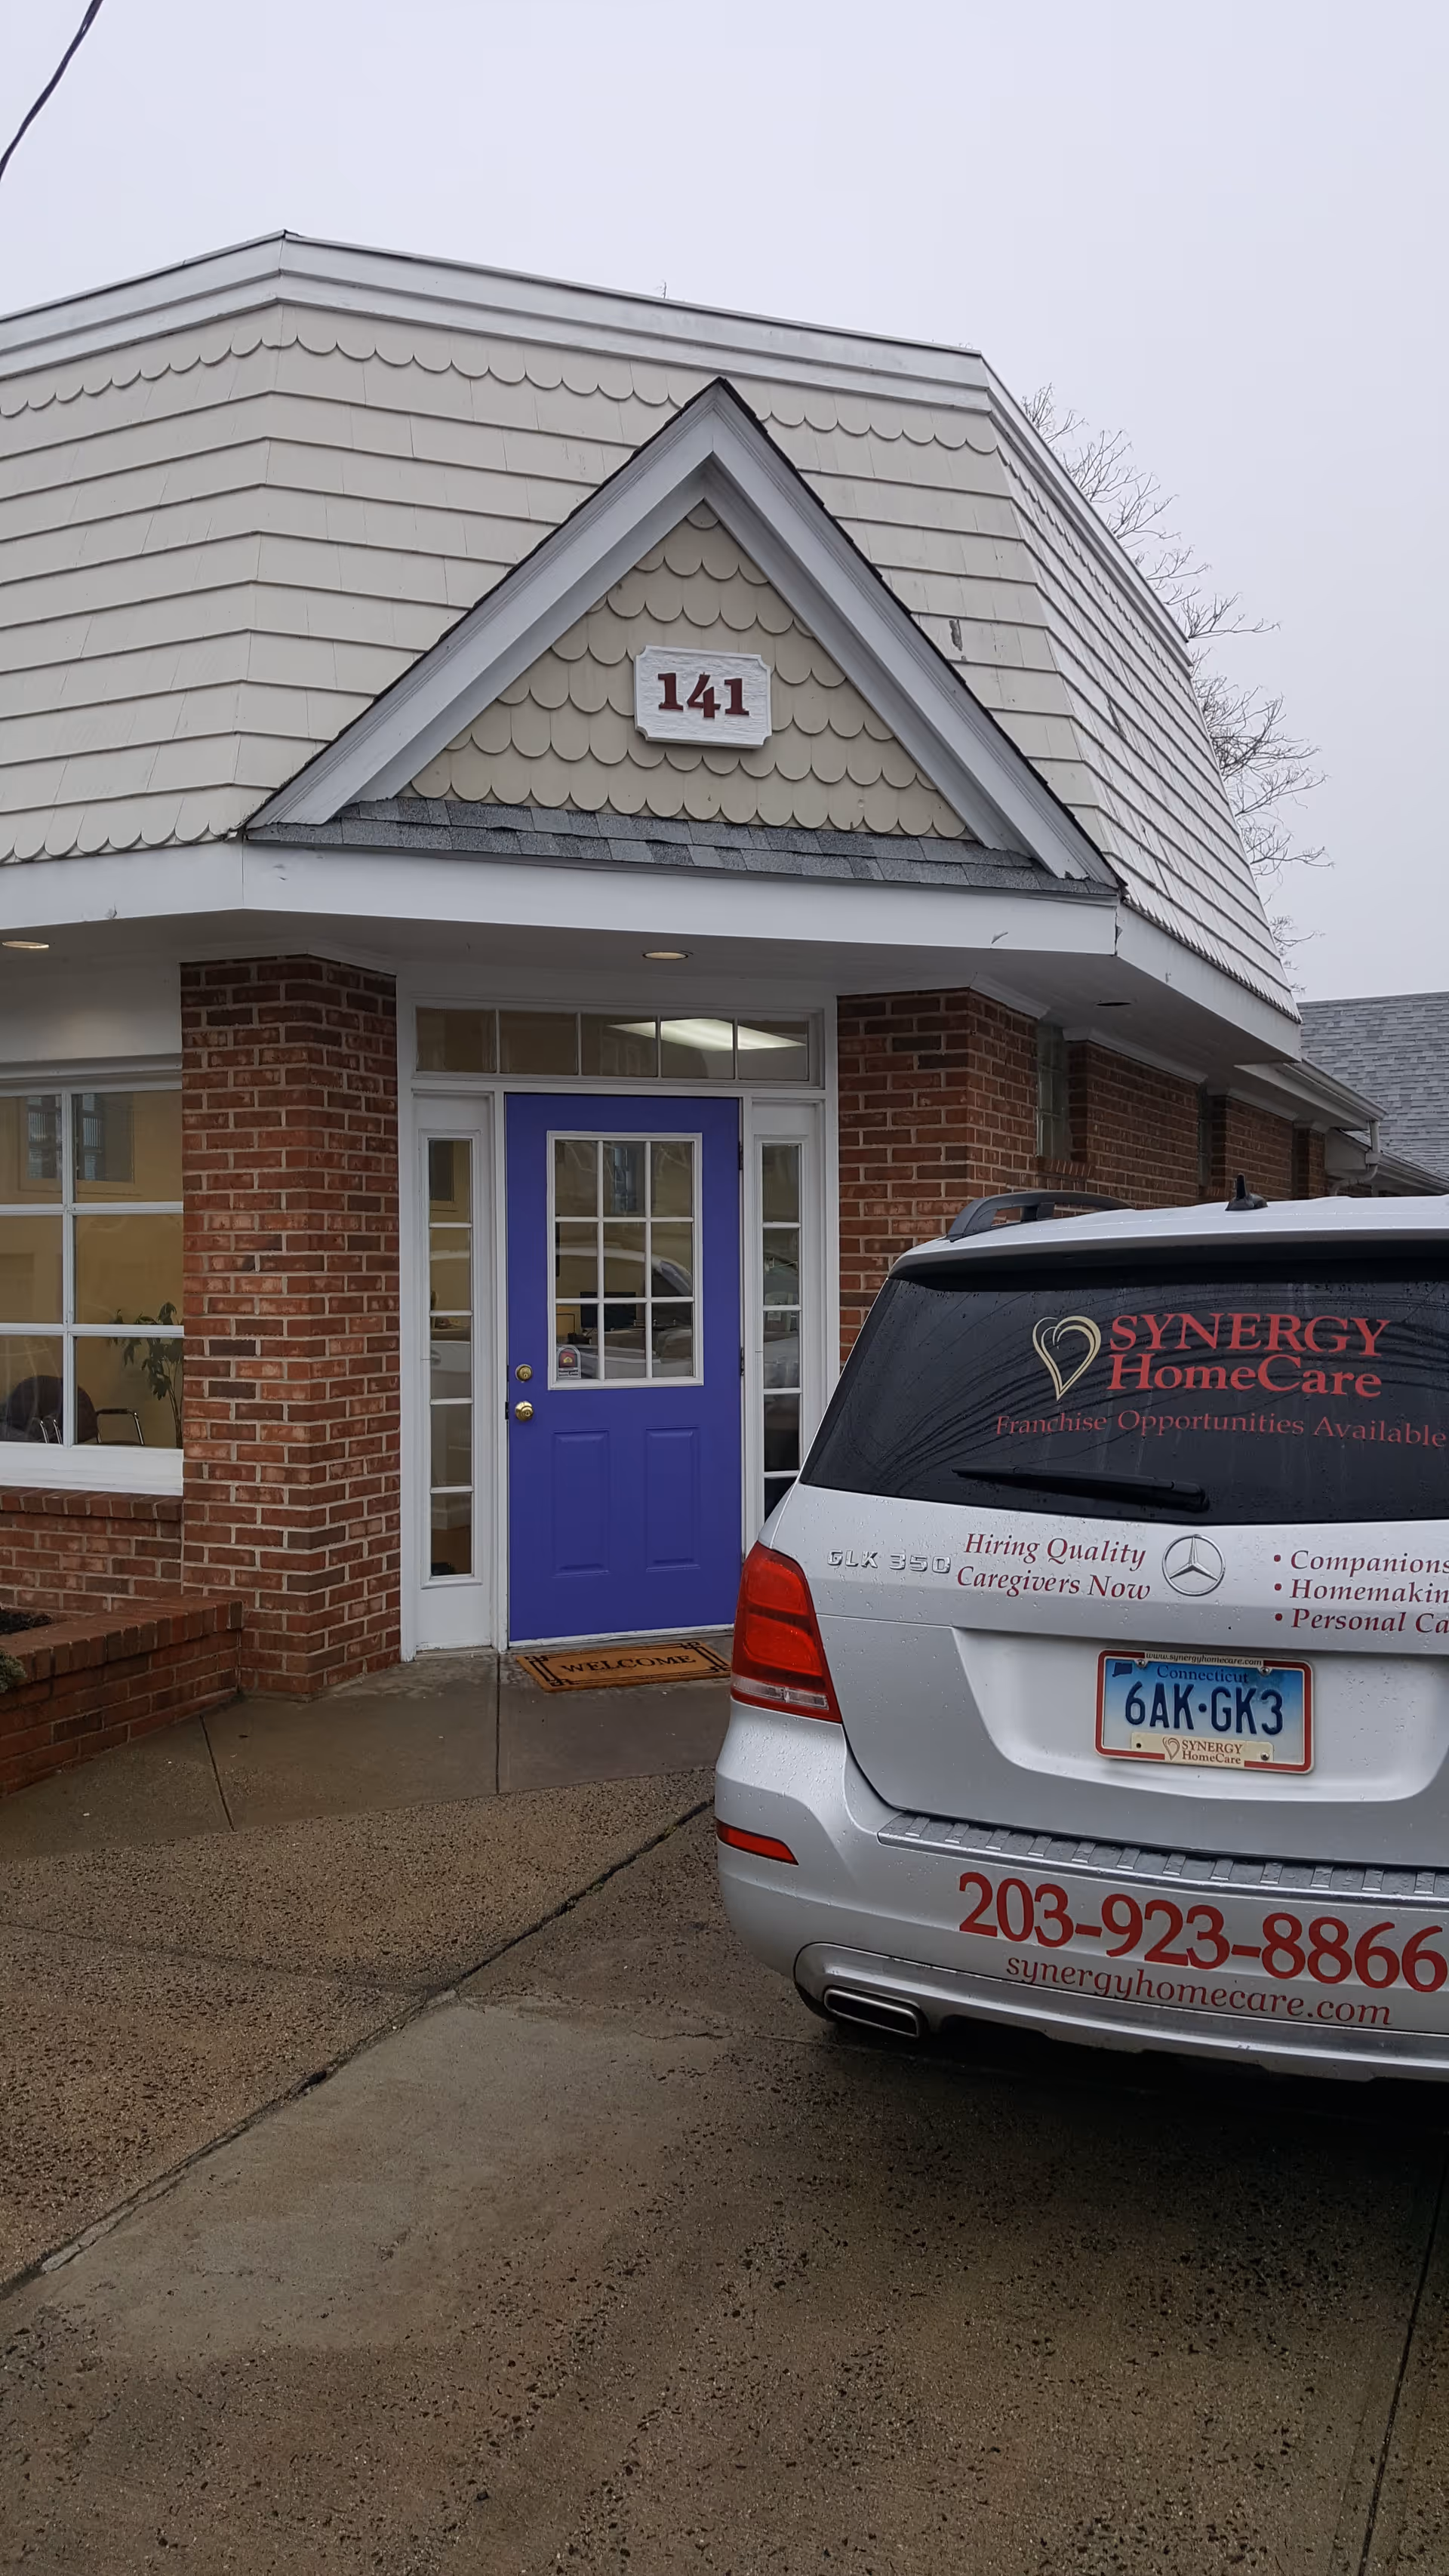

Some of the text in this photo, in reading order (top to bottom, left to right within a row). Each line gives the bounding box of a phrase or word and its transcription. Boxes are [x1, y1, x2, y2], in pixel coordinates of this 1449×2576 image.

[657, 671, 749, 719] 141
[1109, 1313, 1391, 1356] SYNERGY
[1106, 1353, 1383, 1397] HomeCare
[996, 1409, 1447, 1448] Franchise Opportunities Available
[826, 1550, 952, 1574] GLK 350
[963, 1533, 1147, 1571] Hiring Quality
[1291, 1550, 1449, 1578] Companions
[956, 1566, 1151, 1600] Caregivers Now
[1291, 1608, 1407, 1633] Personal
[561, 1654, 697, 1674] WELCOME
[1146, 1651, 1263, 1667] www.synergyhomecare.com
[1157, 1665, 1249, 1684] Connecticut
[1181, 1738, 1243, 1755] SYNERGY
[1181, 1752, 1241, 1765] HomeCare
[958, 1871, 1448, 1993] 203-923-8866
[1006, 1956, 1392, 2026] synergyhomecare.com
